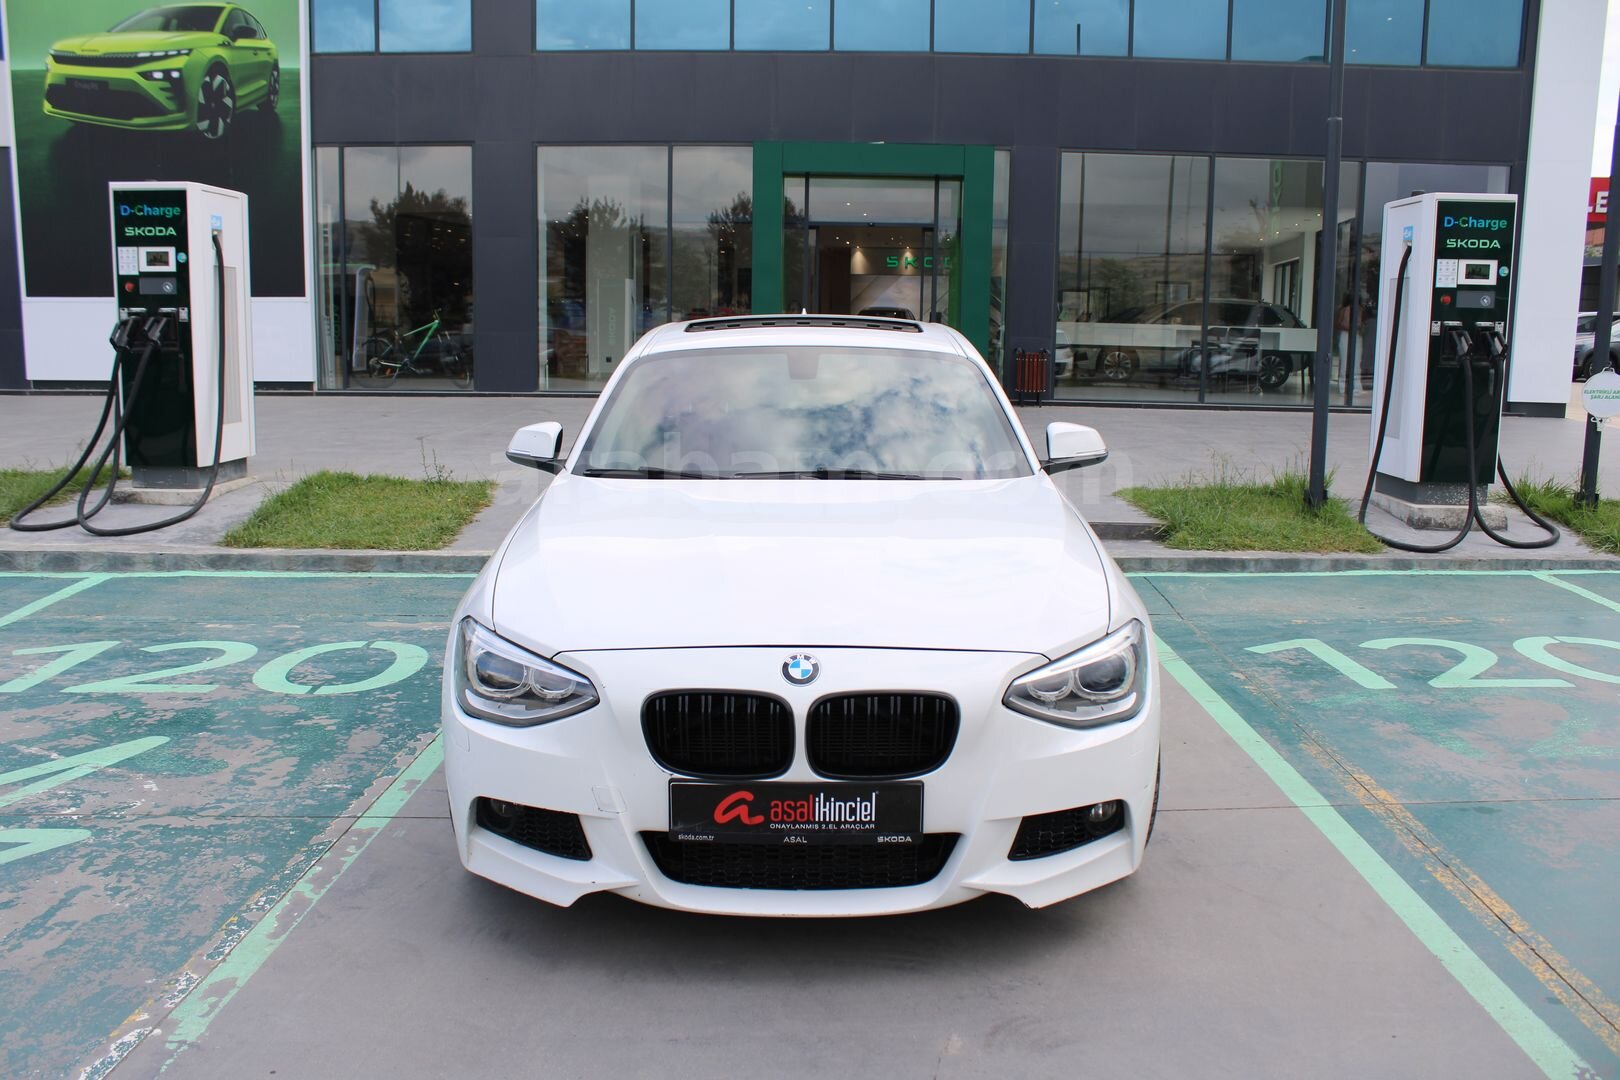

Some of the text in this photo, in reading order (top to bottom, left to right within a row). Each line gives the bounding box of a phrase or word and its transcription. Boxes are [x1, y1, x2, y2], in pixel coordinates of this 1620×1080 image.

[120, 204, 181, 218] D-Charge
[1443, 216, 1508, 231] D-Charge
[124, 227, 177, 236] SKODA
[1446, 239, 1501, 248] SKODA
[0, 640, 429, 694] 120
[770, 792, 876, 822] asalikinciel
